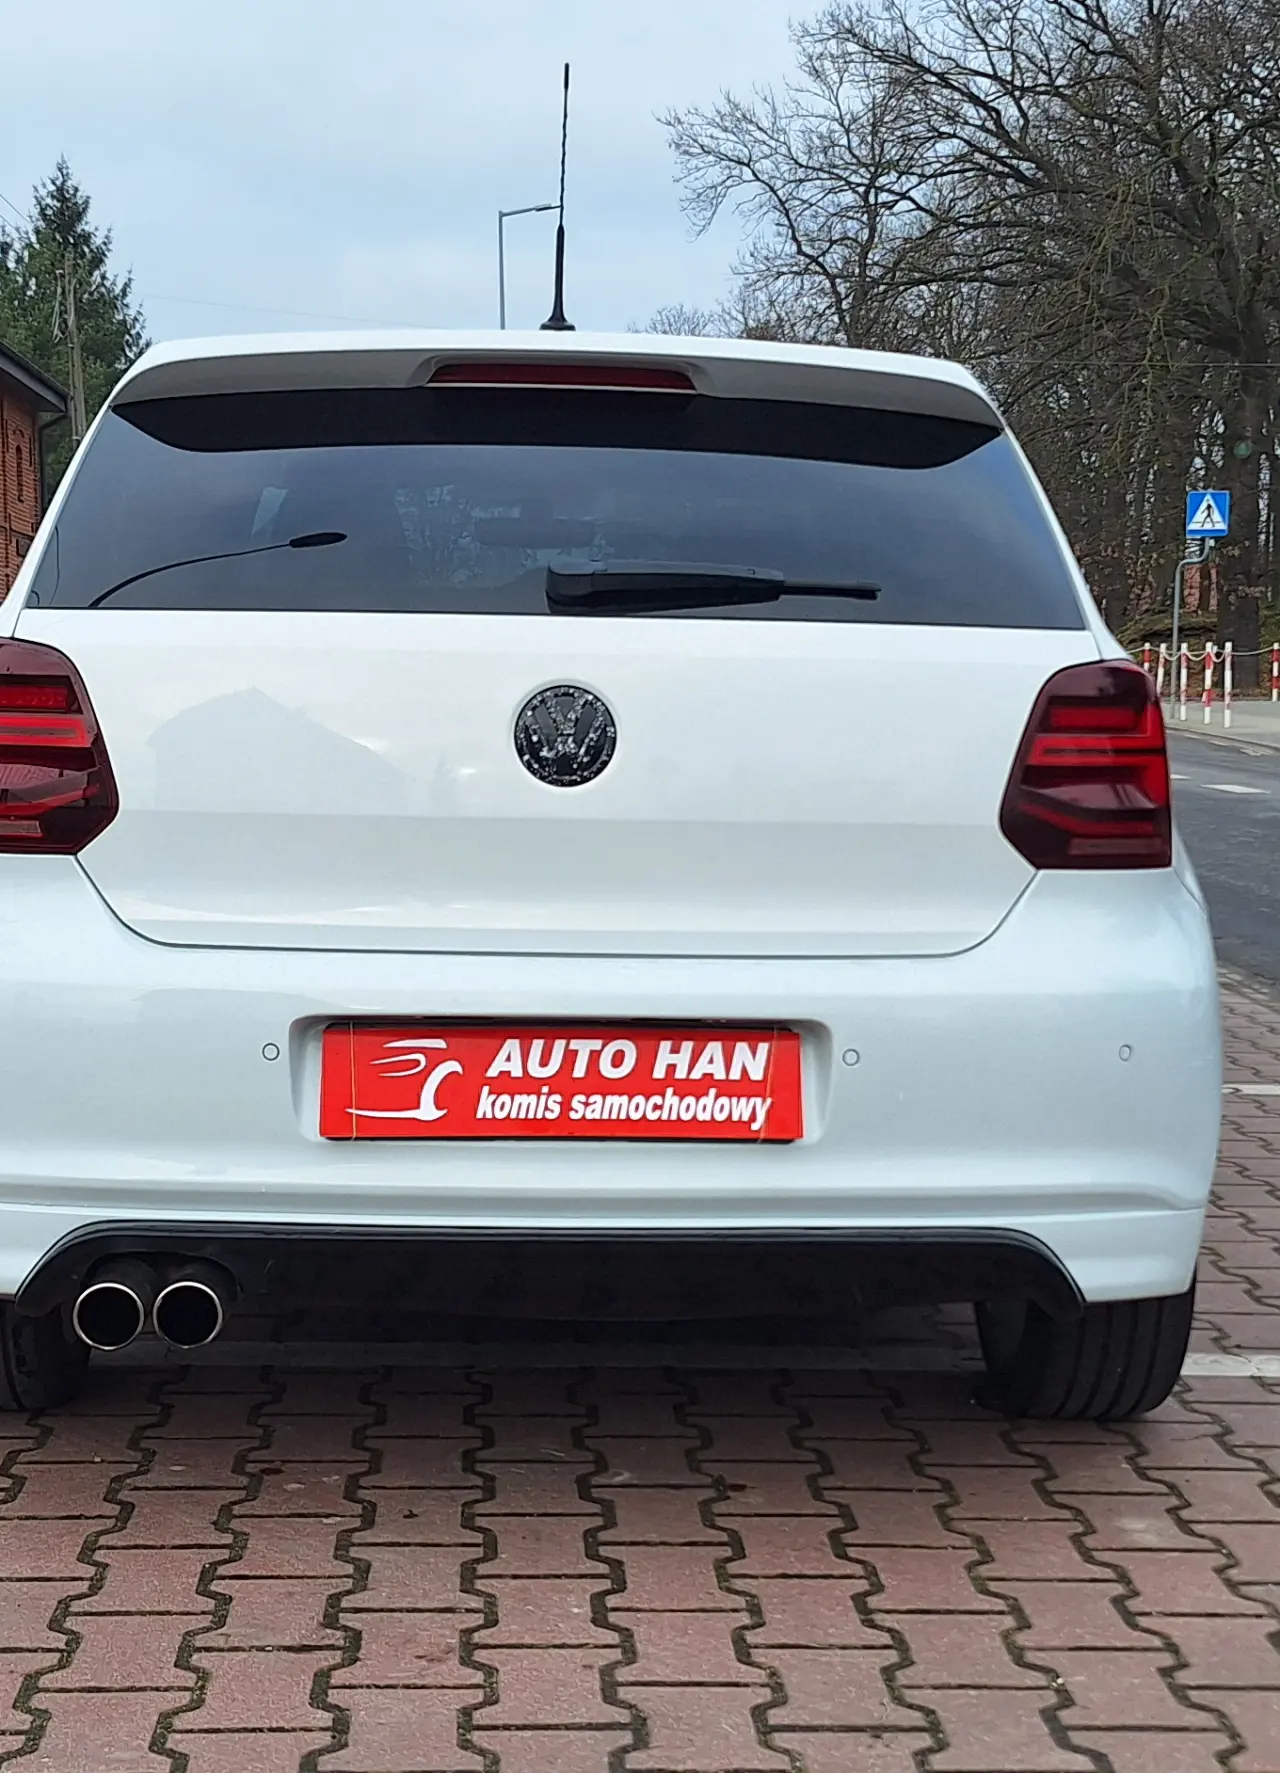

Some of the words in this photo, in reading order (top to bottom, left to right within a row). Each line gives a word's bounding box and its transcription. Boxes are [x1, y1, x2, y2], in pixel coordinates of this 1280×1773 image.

[485, 1038, 638, 1079] AUTO
[651, 1040, 769, 1082] HAN
[476, 1086, 561, 1120] komis
[568, 1086, 772, 1131] samochodowy
